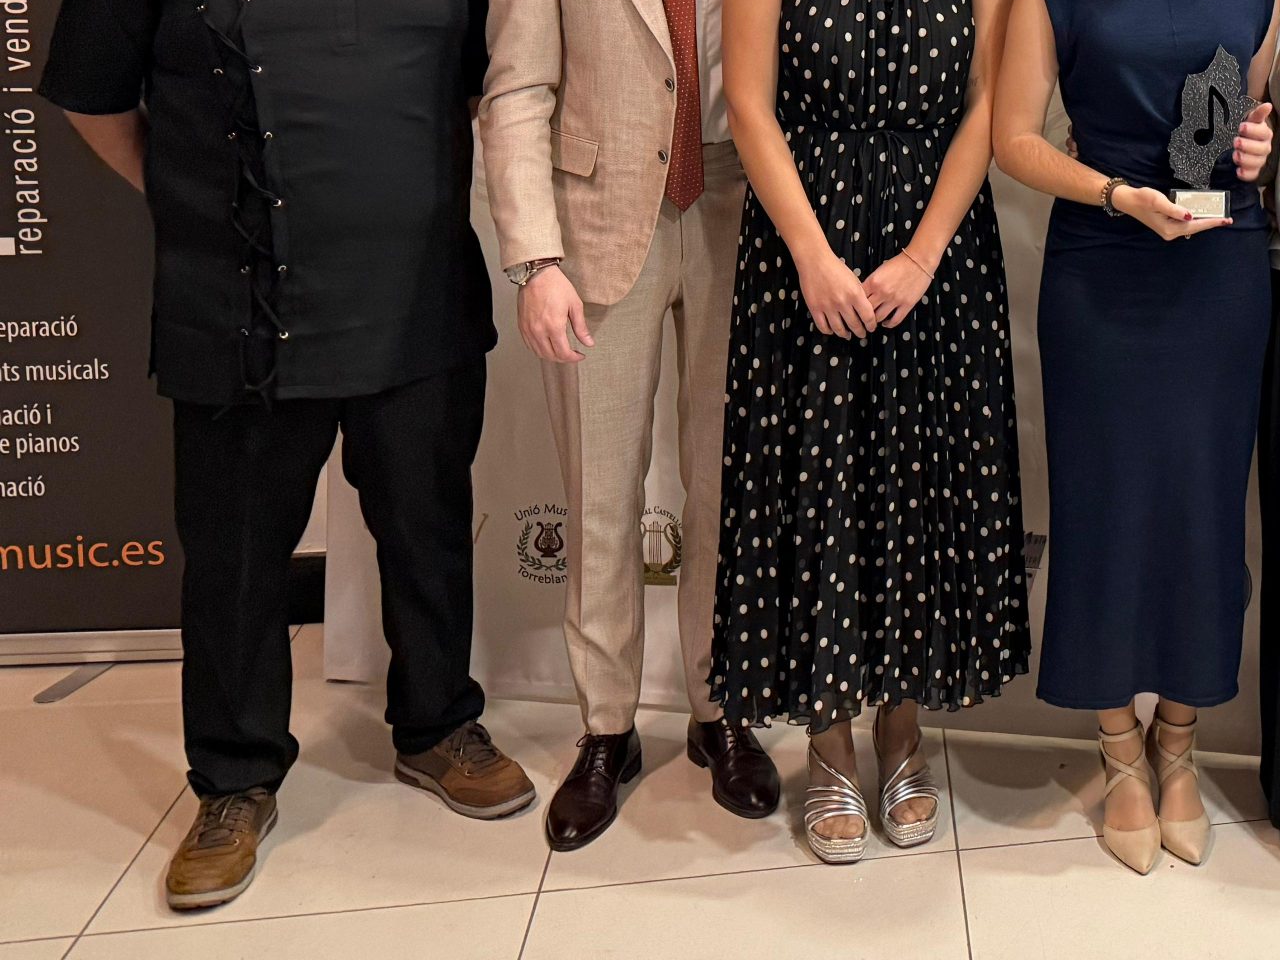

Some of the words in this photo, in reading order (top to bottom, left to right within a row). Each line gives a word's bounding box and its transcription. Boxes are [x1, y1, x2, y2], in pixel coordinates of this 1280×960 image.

[5, 107, 48, 256] reparació
[0, 362, 20, 382] ts
[25, 358, 110, 382] musicals
[0, 403, 41, 426] ació
[46, 404, 52, 425] i
[16, 433, 80, 458] pianos
[514, 504, 540, 521] Unió
[0, 535, 166, 571] music.es
